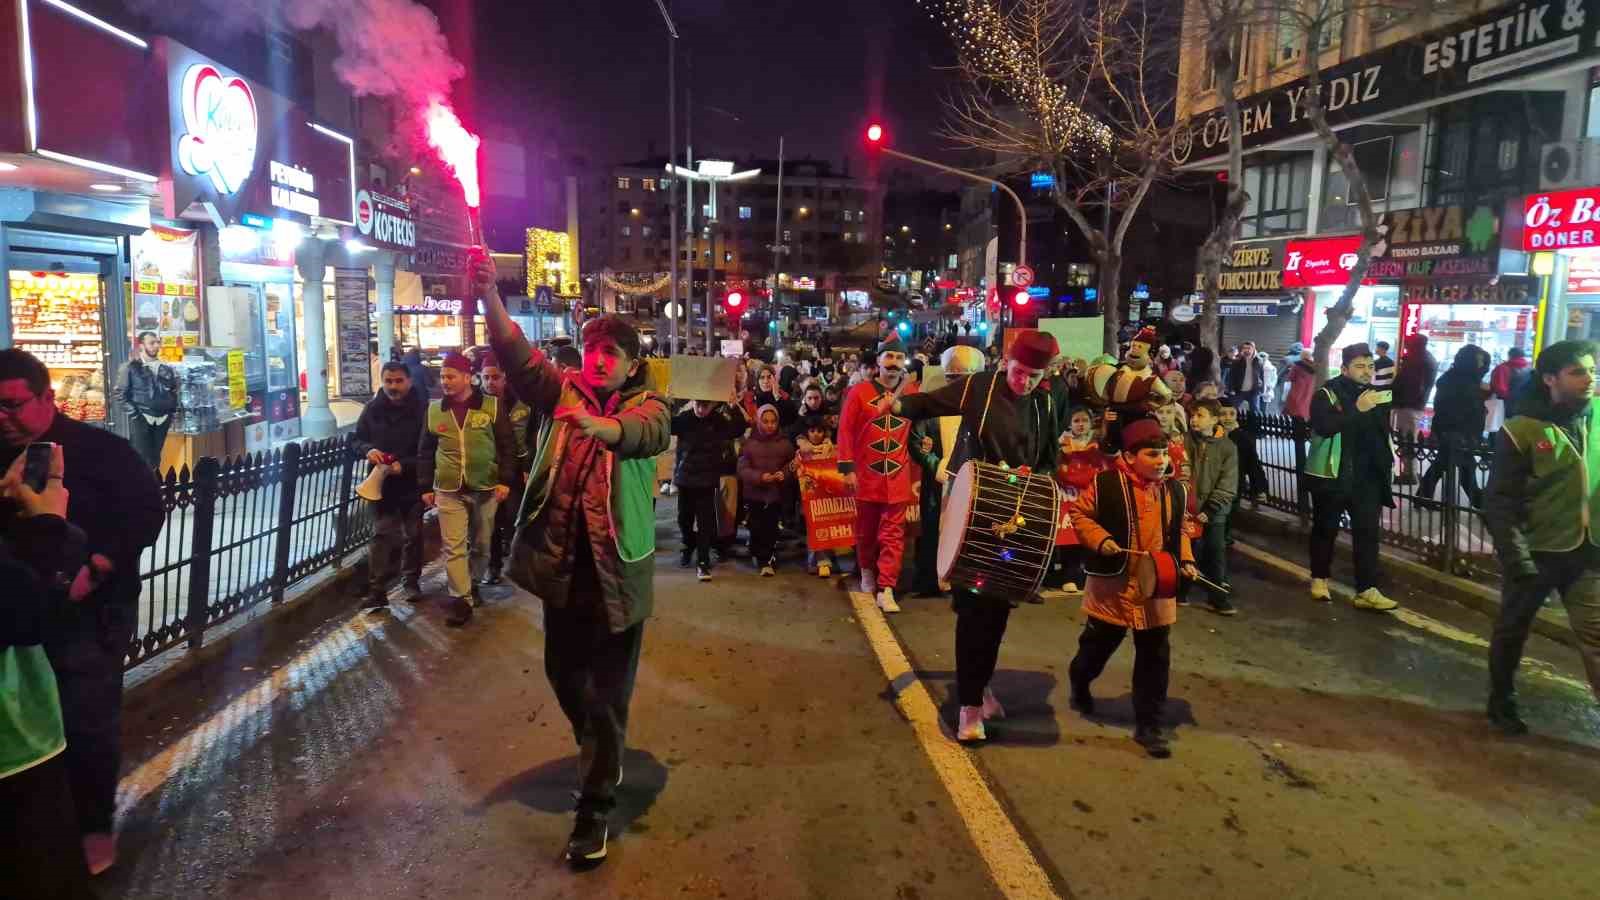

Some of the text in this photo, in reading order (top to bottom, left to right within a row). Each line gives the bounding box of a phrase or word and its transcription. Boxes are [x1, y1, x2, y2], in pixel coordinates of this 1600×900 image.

[1423, 3, 1550, 75] ESTETİK
[1561, 0, 1586, 31] &
[1202, 101, 1273, 148] ÖZEM
[1526, 197, 1562, 228] Öz
[1531, 229, 1594, 248] DÖNER
[1232, 246, 1270, 267] ZİRVE
